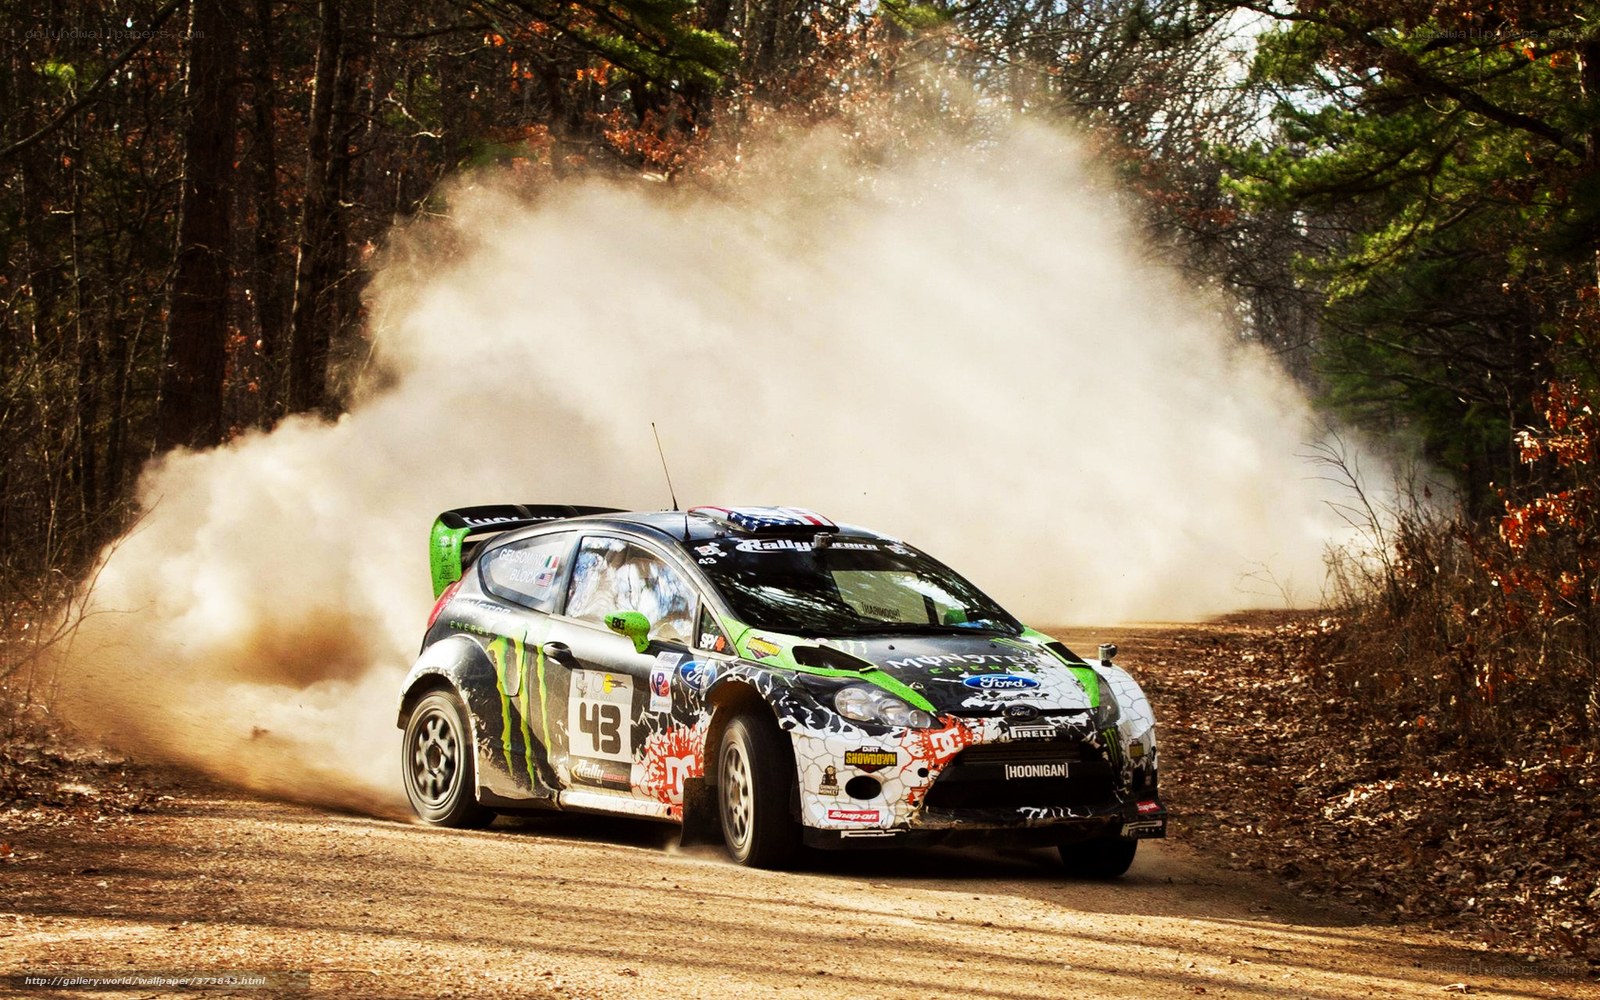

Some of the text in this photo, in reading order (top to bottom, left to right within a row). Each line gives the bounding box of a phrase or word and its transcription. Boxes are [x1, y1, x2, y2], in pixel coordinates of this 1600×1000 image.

[742, 539, 812, 552] Rally
[698, 557, 717, 565] 43
[980, 675, 1027, 688] Ford
[1010, 706, 1031, 717] Ford
[579, 701, 622, 755] 43
[1009, 725, 1057, 739] PIRELLI
[845, 752, 897, 766] SHOWDOWN
[576, 759, 604, 785] Rally
[829, 811, 878, 821] Snap-on
